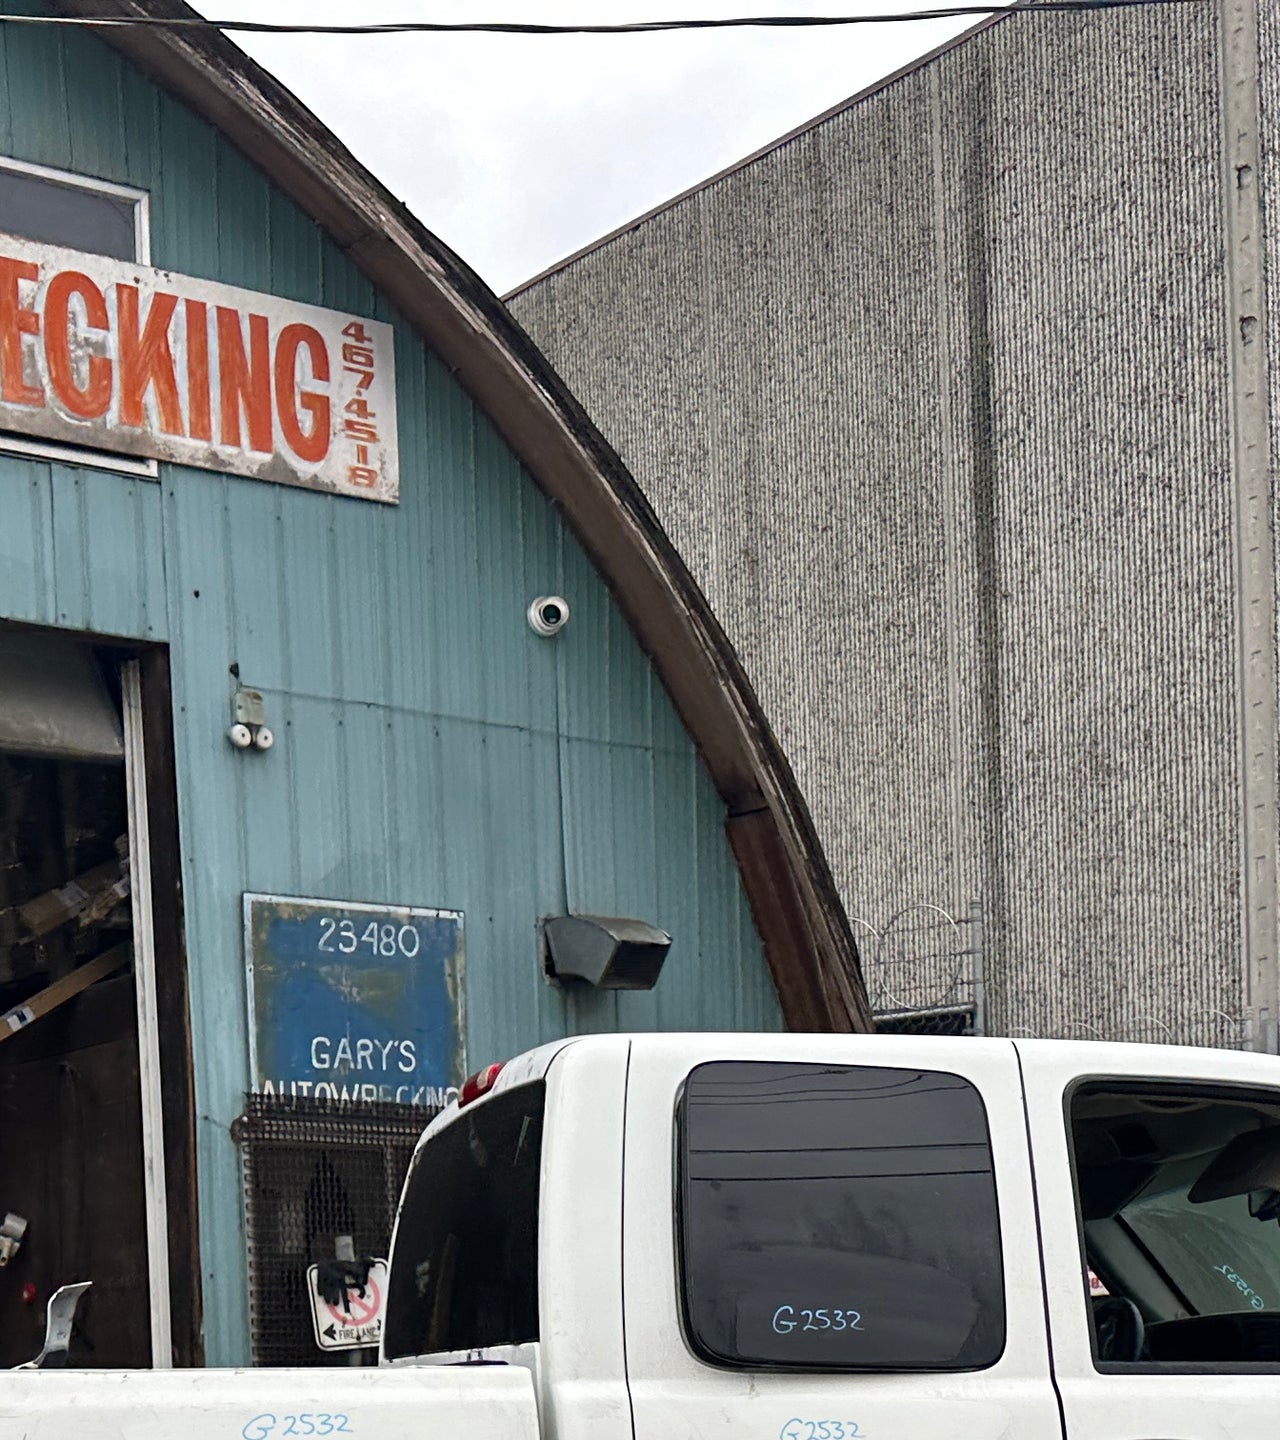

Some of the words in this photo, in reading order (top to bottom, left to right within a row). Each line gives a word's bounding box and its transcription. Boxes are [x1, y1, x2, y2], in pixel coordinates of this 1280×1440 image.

[317, 917, 420, 958] 23480
[311, 1036, 417, 1073] GARY'S
[338, 1328, 355, 1340] FIRE
[772, 1305, 865, 1335] G2532
